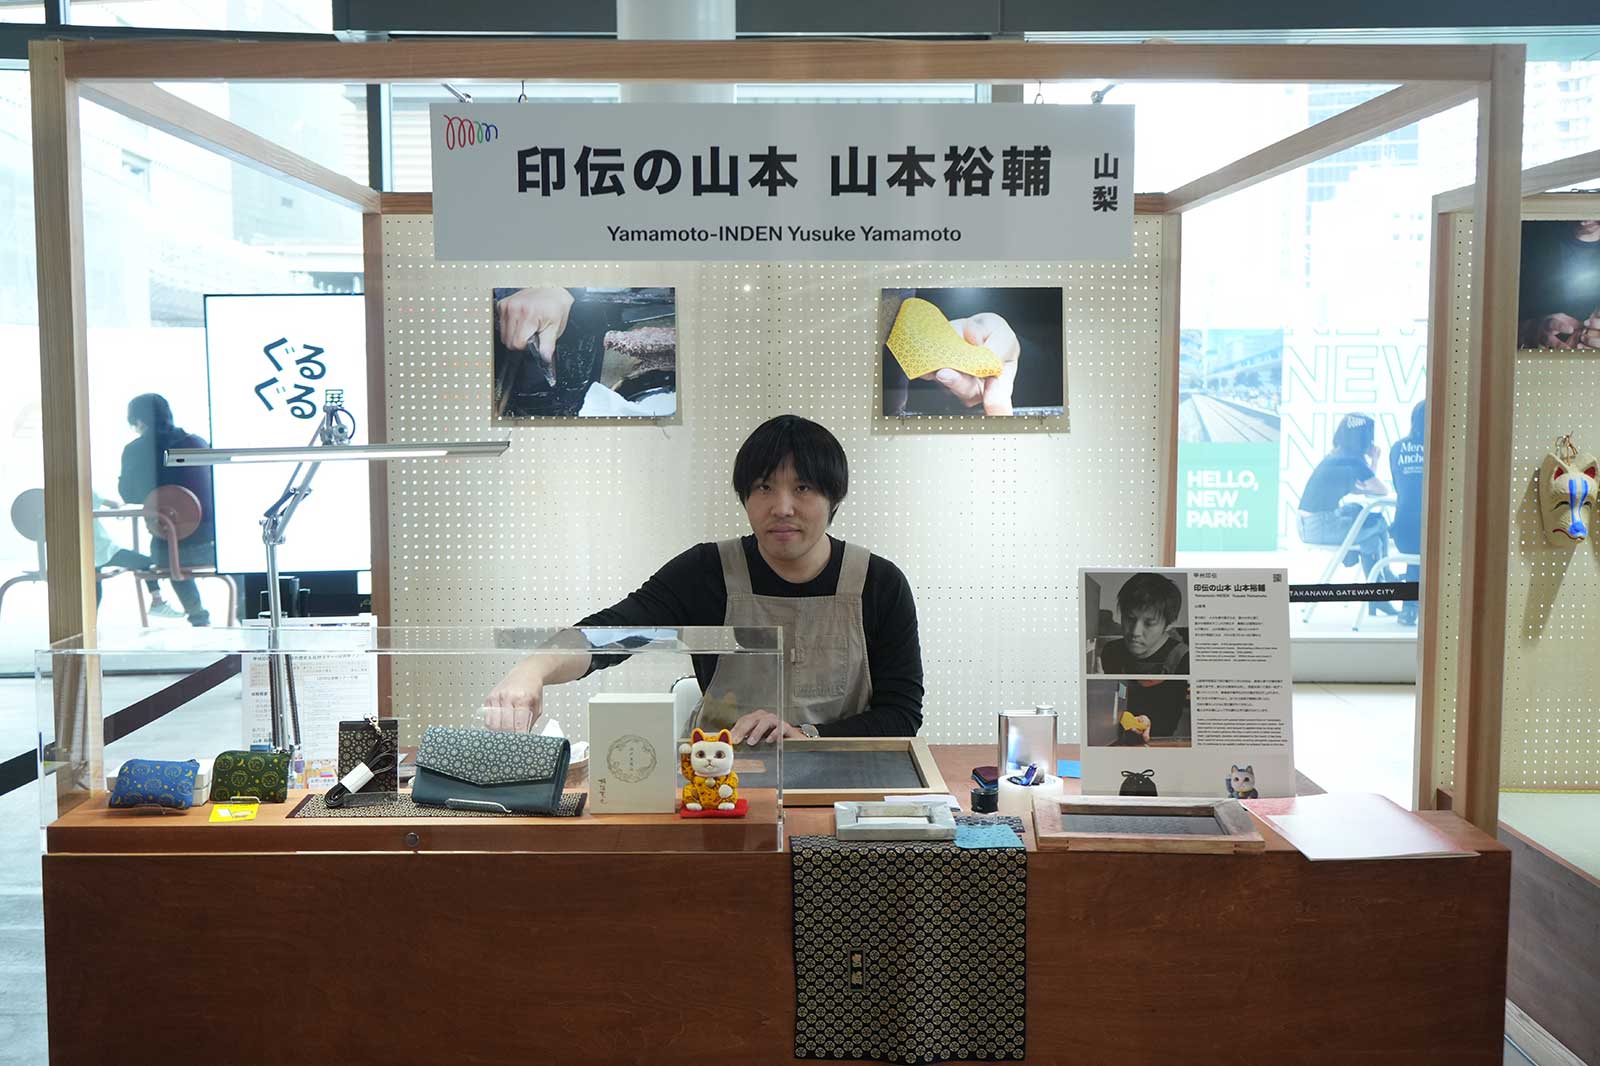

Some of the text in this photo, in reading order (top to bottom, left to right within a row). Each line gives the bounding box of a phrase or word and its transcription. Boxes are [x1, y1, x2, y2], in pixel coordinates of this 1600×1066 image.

[517, 145, 1052, 197] 印伝の山本 山本裕輔
[1093, 153, 1119, 212] 山梨
[607, 225, 962, 242] Yamamoto-INDEN Yusuke Yamamoto
[1187, 470, 1259, 491] HELLO,
[1187, 490, 1239, 508] NEW
[1187, 510, 1249, 529] PARK!
[1376, 588, 1395, 596] CITY
